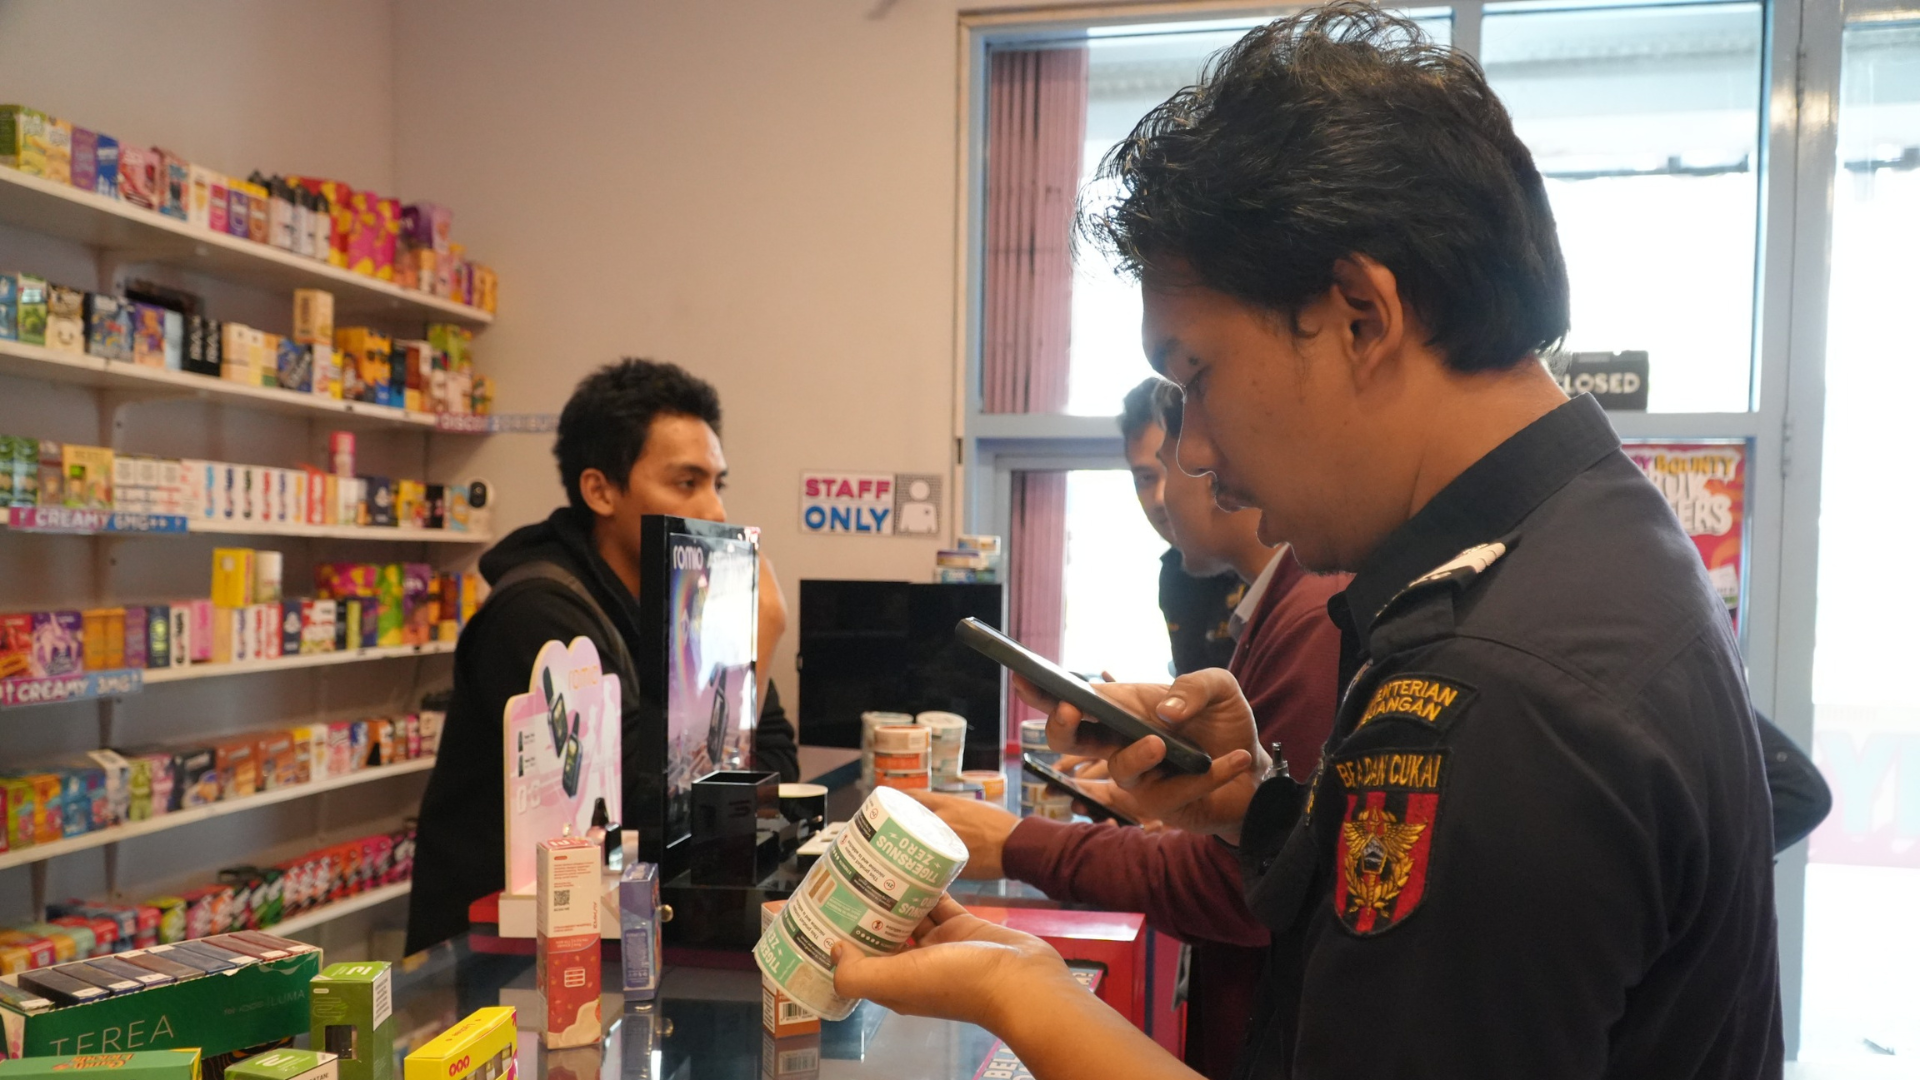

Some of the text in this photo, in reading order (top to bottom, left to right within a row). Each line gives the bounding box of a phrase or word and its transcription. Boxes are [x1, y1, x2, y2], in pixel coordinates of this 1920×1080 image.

[1560, 372, 1640, 394] LOSED
[1655, 453, 1734, 476] BOUNTY
[805, 477, 890, 499] STAFF
[35, 509, 108, 529] CREAMY
[804, 505, 890, 532] ONLY
[17, 677, 89, 700] CREAMY
[1376, 680, 1458, 707] ENTERIAN
[1362, 697, 1441, 722] UANGAN
[1363, 755, 1389, 787] DAN
[1389, 754, 1442, 788] CUKAI
[876, 835, 939, 883] TIGERSNUS
[899, 837, 935, 865] ZERO
[49, 1014, 174, 1056] TEREA
